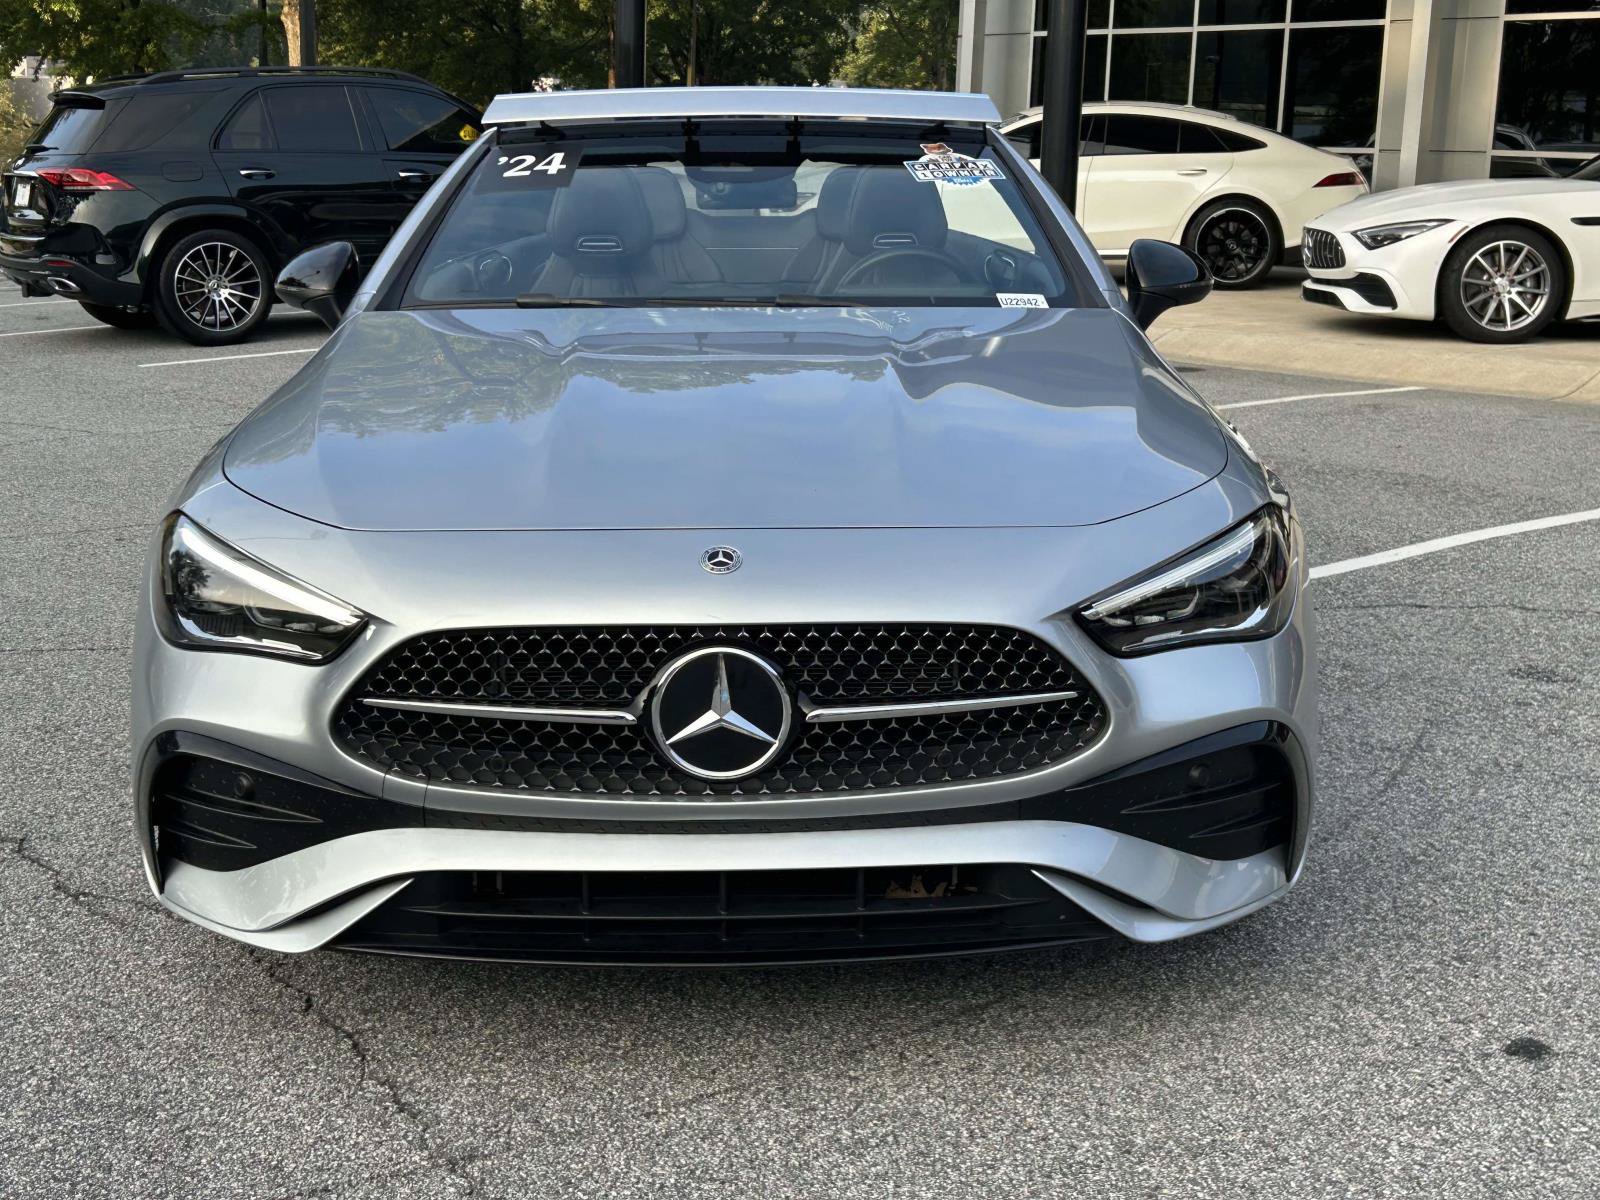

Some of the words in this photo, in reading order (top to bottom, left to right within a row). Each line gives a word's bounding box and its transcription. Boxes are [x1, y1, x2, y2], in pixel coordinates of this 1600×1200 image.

[914, 161, 993, 171] CARFAX
[919, 170, 930, 179] 1
[932, 169, 997, 179] OWNER
[999, 297, 1041, 307] U22942
